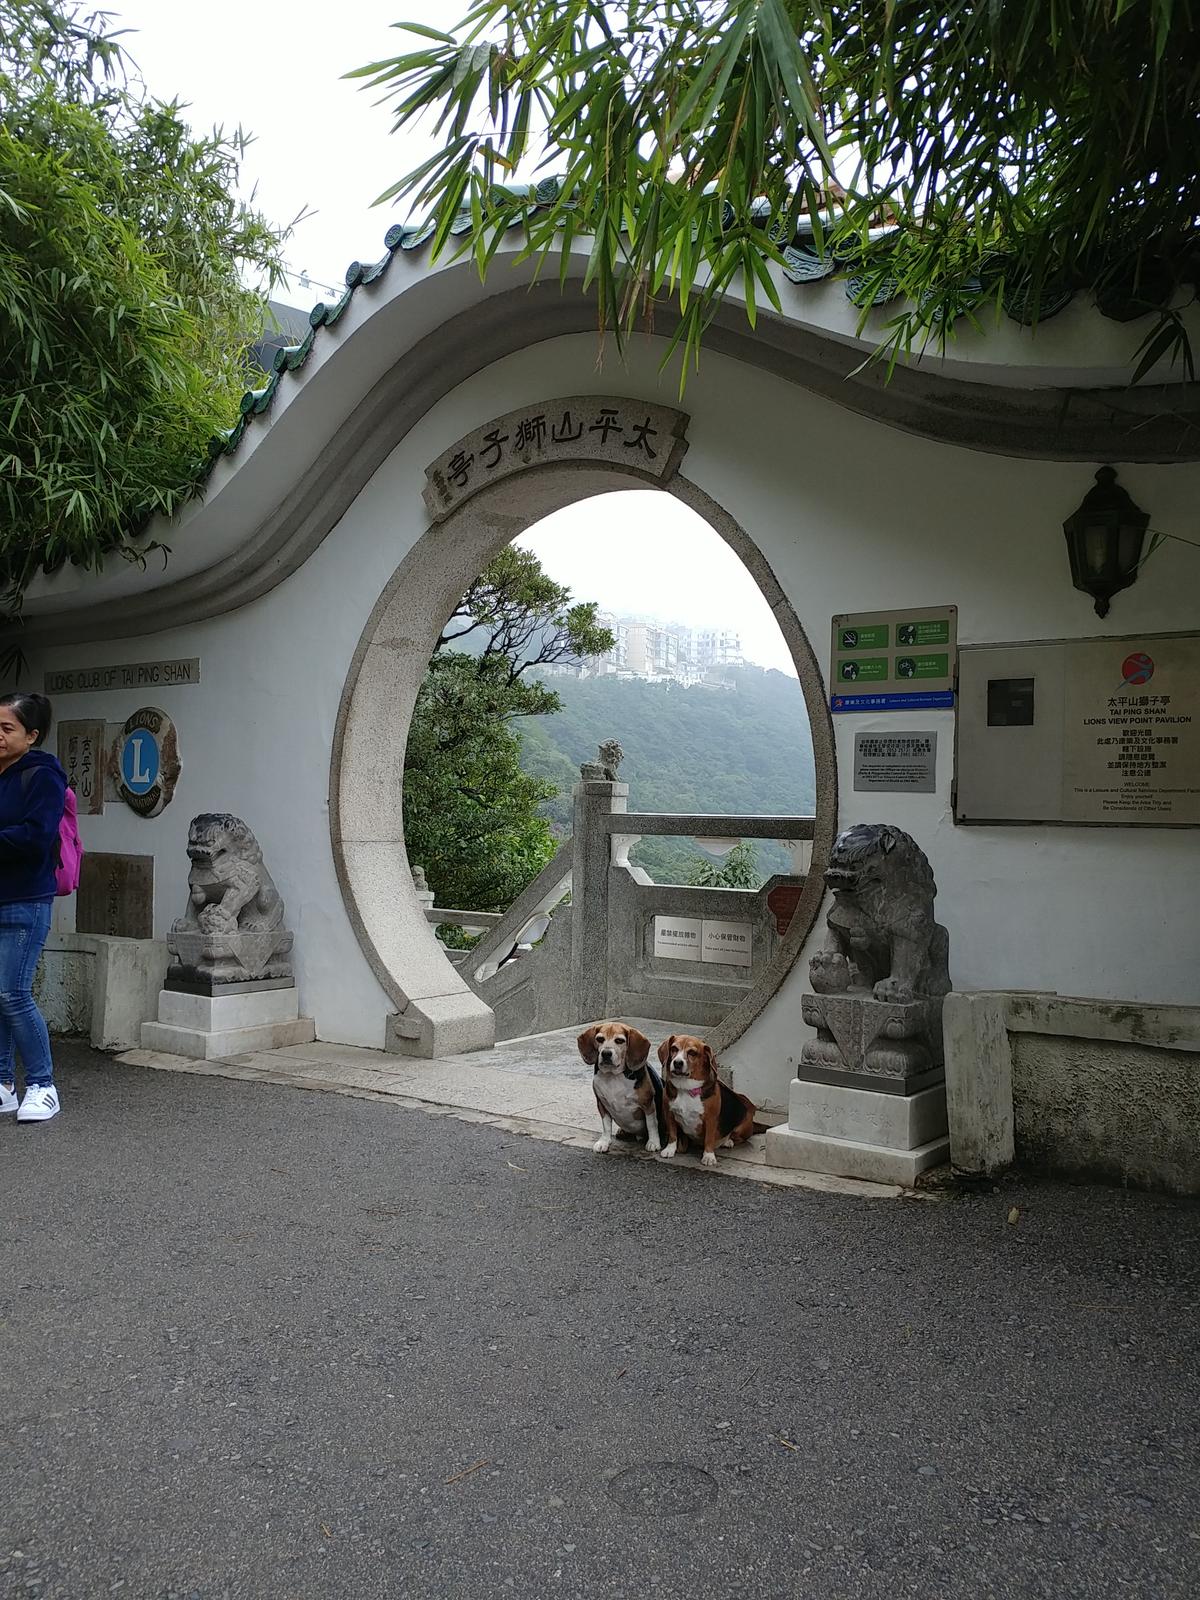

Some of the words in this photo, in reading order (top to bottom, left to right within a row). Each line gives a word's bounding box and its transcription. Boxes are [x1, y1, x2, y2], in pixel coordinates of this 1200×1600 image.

[447, 409, 657, 487] 太平山獅子亭
[51, 674, 74, 691] LIONS
[78, 672, 100, 689] CLUB
[104, 670, 116, 687] OF
[121, 668, 134, 685] TAI
[138, 665, 159, 683] PING
[163, 663, 191, 681] SHAN
[1107, 695, 1171, 707] 太平山獅子亭
[129, 710, 159, 729] LIONS
[1083, 718, 1107, 726] LIONS
[1108, 717, 1128, 725] VIEW
[1129, 716, 1154, 725] POINT
[1155, 715, 1192, 724] PAVILION
[1123, 708, 1142, 716] PING
[1144, 707, 1167, 715] SHAN
[130, 738, 150, 783] L
